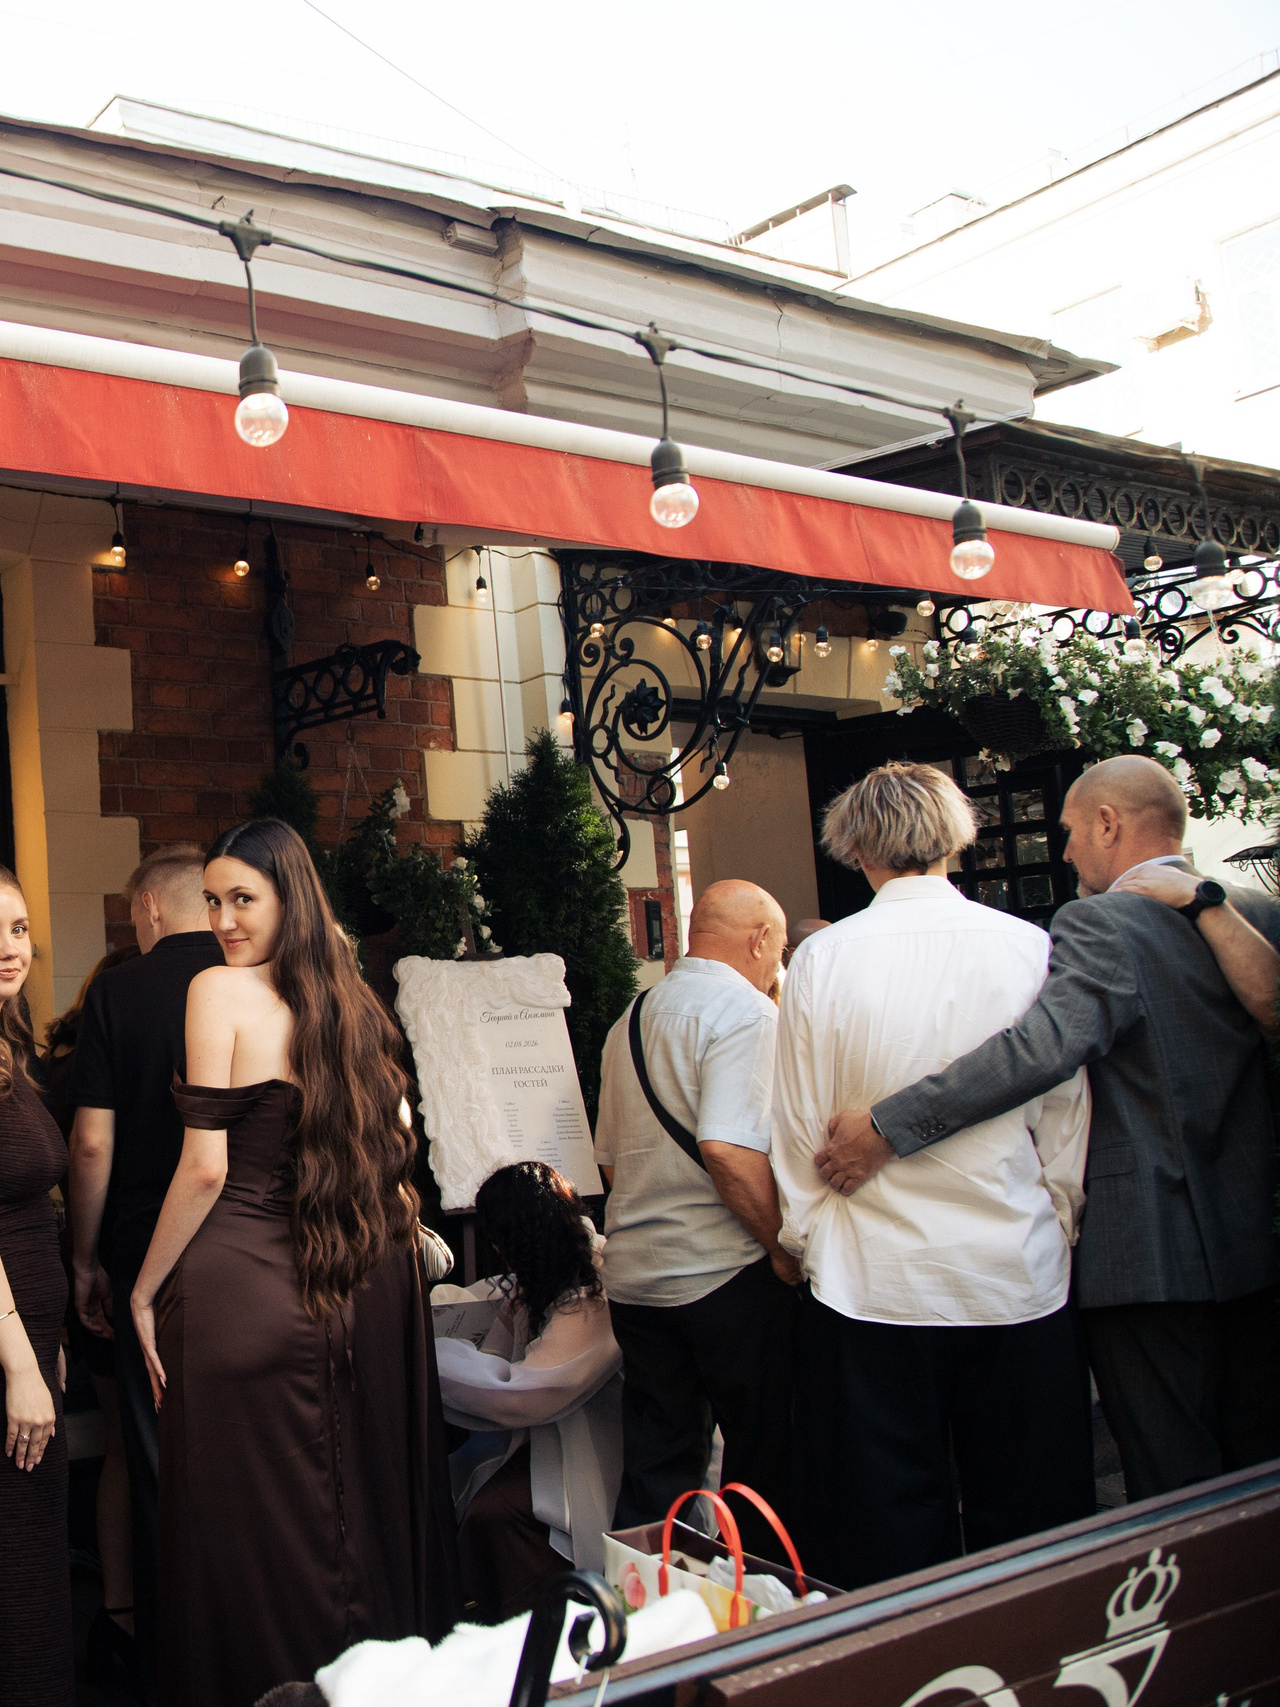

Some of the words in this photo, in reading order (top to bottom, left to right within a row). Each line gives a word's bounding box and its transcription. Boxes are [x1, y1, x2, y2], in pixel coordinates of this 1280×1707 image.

[491, 1066, 517, 1075] ПЛАН
[519, 1065, 565, 1074] РАССАДКИ
[513, 1078, 548, 1088] ГОСТЕЙ
